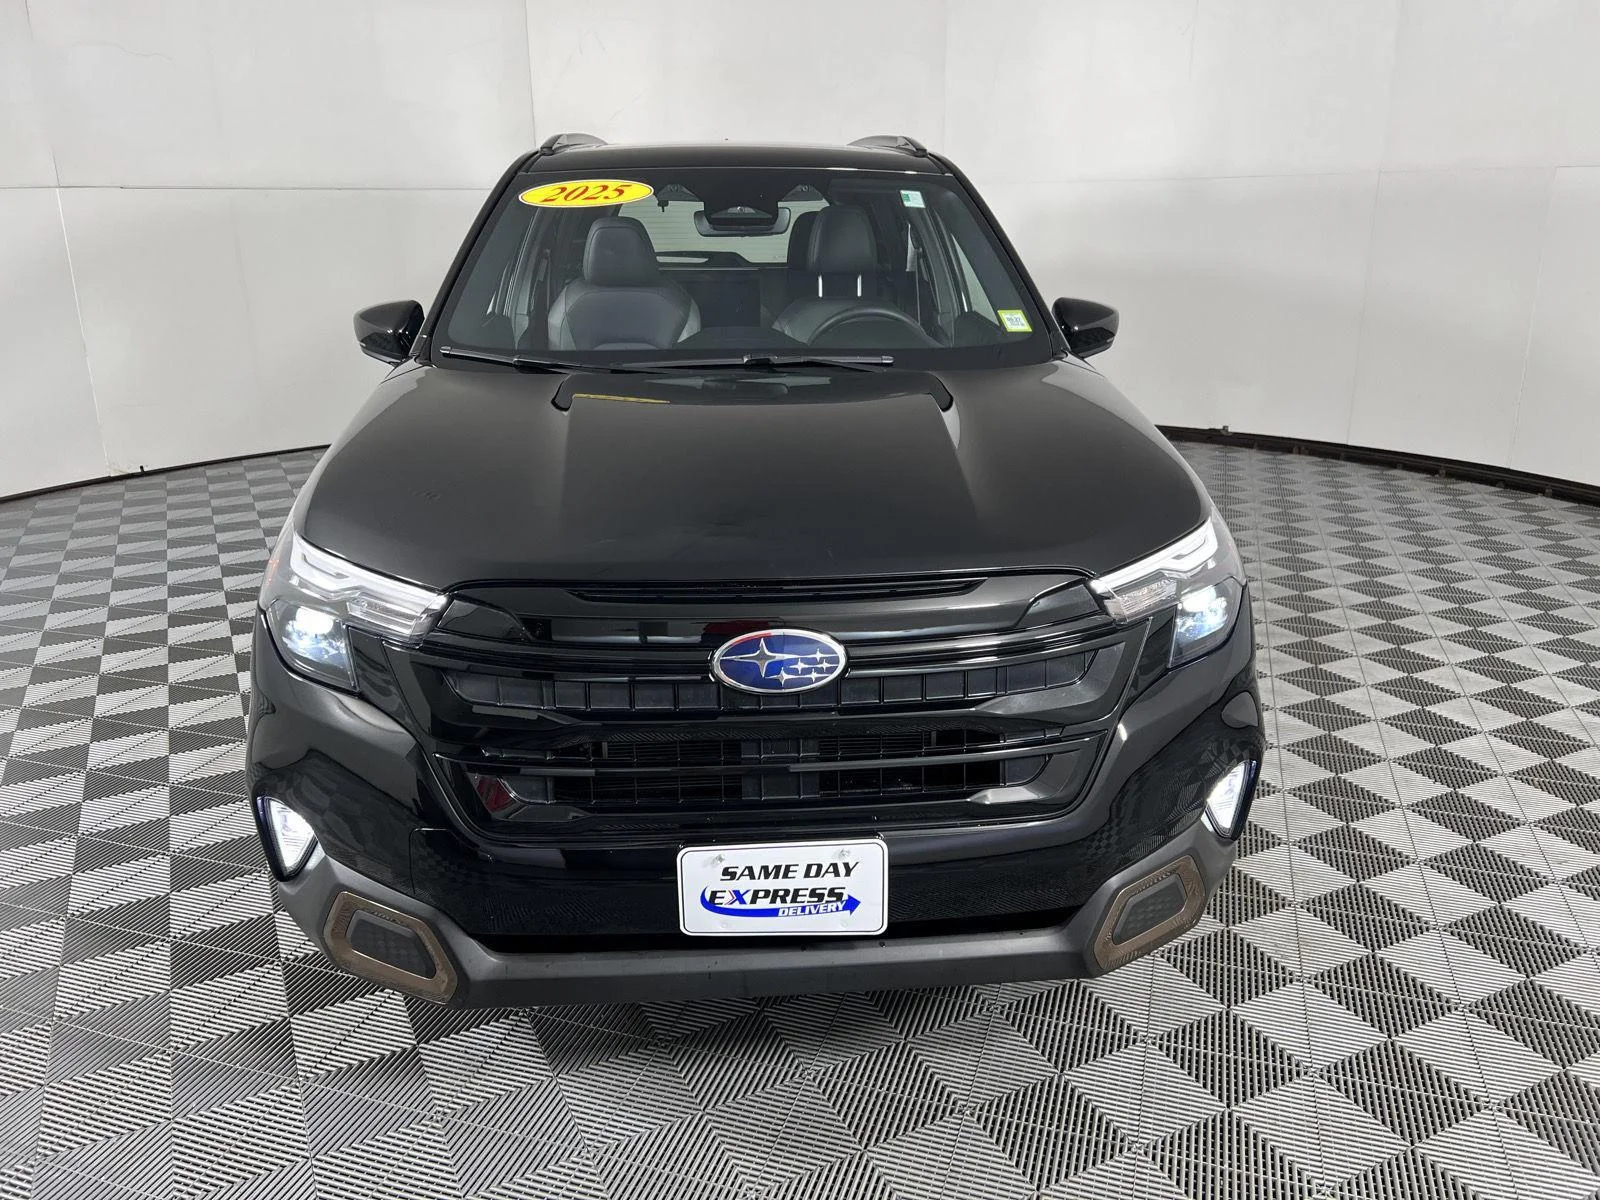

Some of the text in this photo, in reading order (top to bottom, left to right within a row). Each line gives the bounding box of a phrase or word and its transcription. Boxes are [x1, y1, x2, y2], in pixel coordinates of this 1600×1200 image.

[540, 184, 632, 203] 2025
[720, 861, 860, 882] SAME DAY
[708, 886, 846, 905] EXPRESS
[778, 900, 846, 917] DELIVERY
